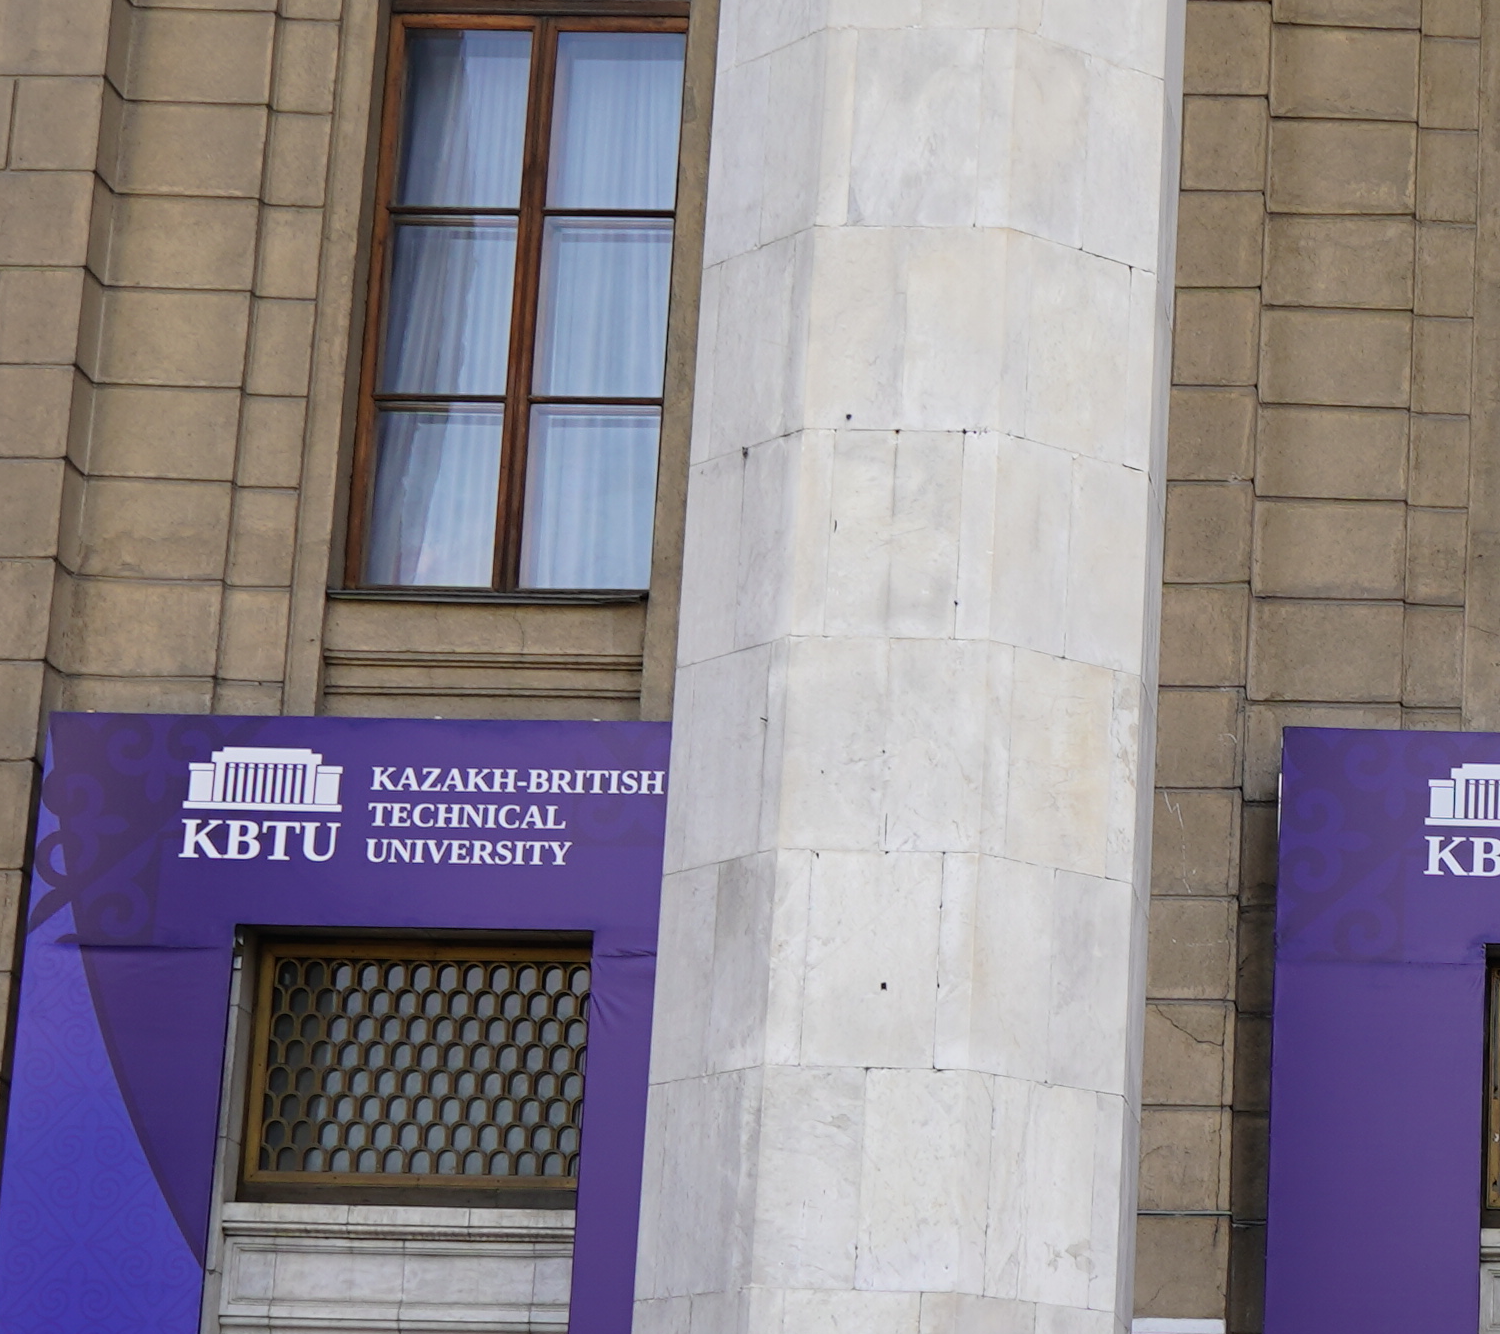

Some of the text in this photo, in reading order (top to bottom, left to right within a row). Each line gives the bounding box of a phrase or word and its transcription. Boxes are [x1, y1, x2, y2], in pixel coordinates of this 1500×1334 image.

[371, 767, 665, 794] KAZAKH-BRITISH
[369, 803, 566, 829] TECHNICAL
[179, 819, 341, 861] KBTU
[367, 839, 572, 865] UNIVERSITY
